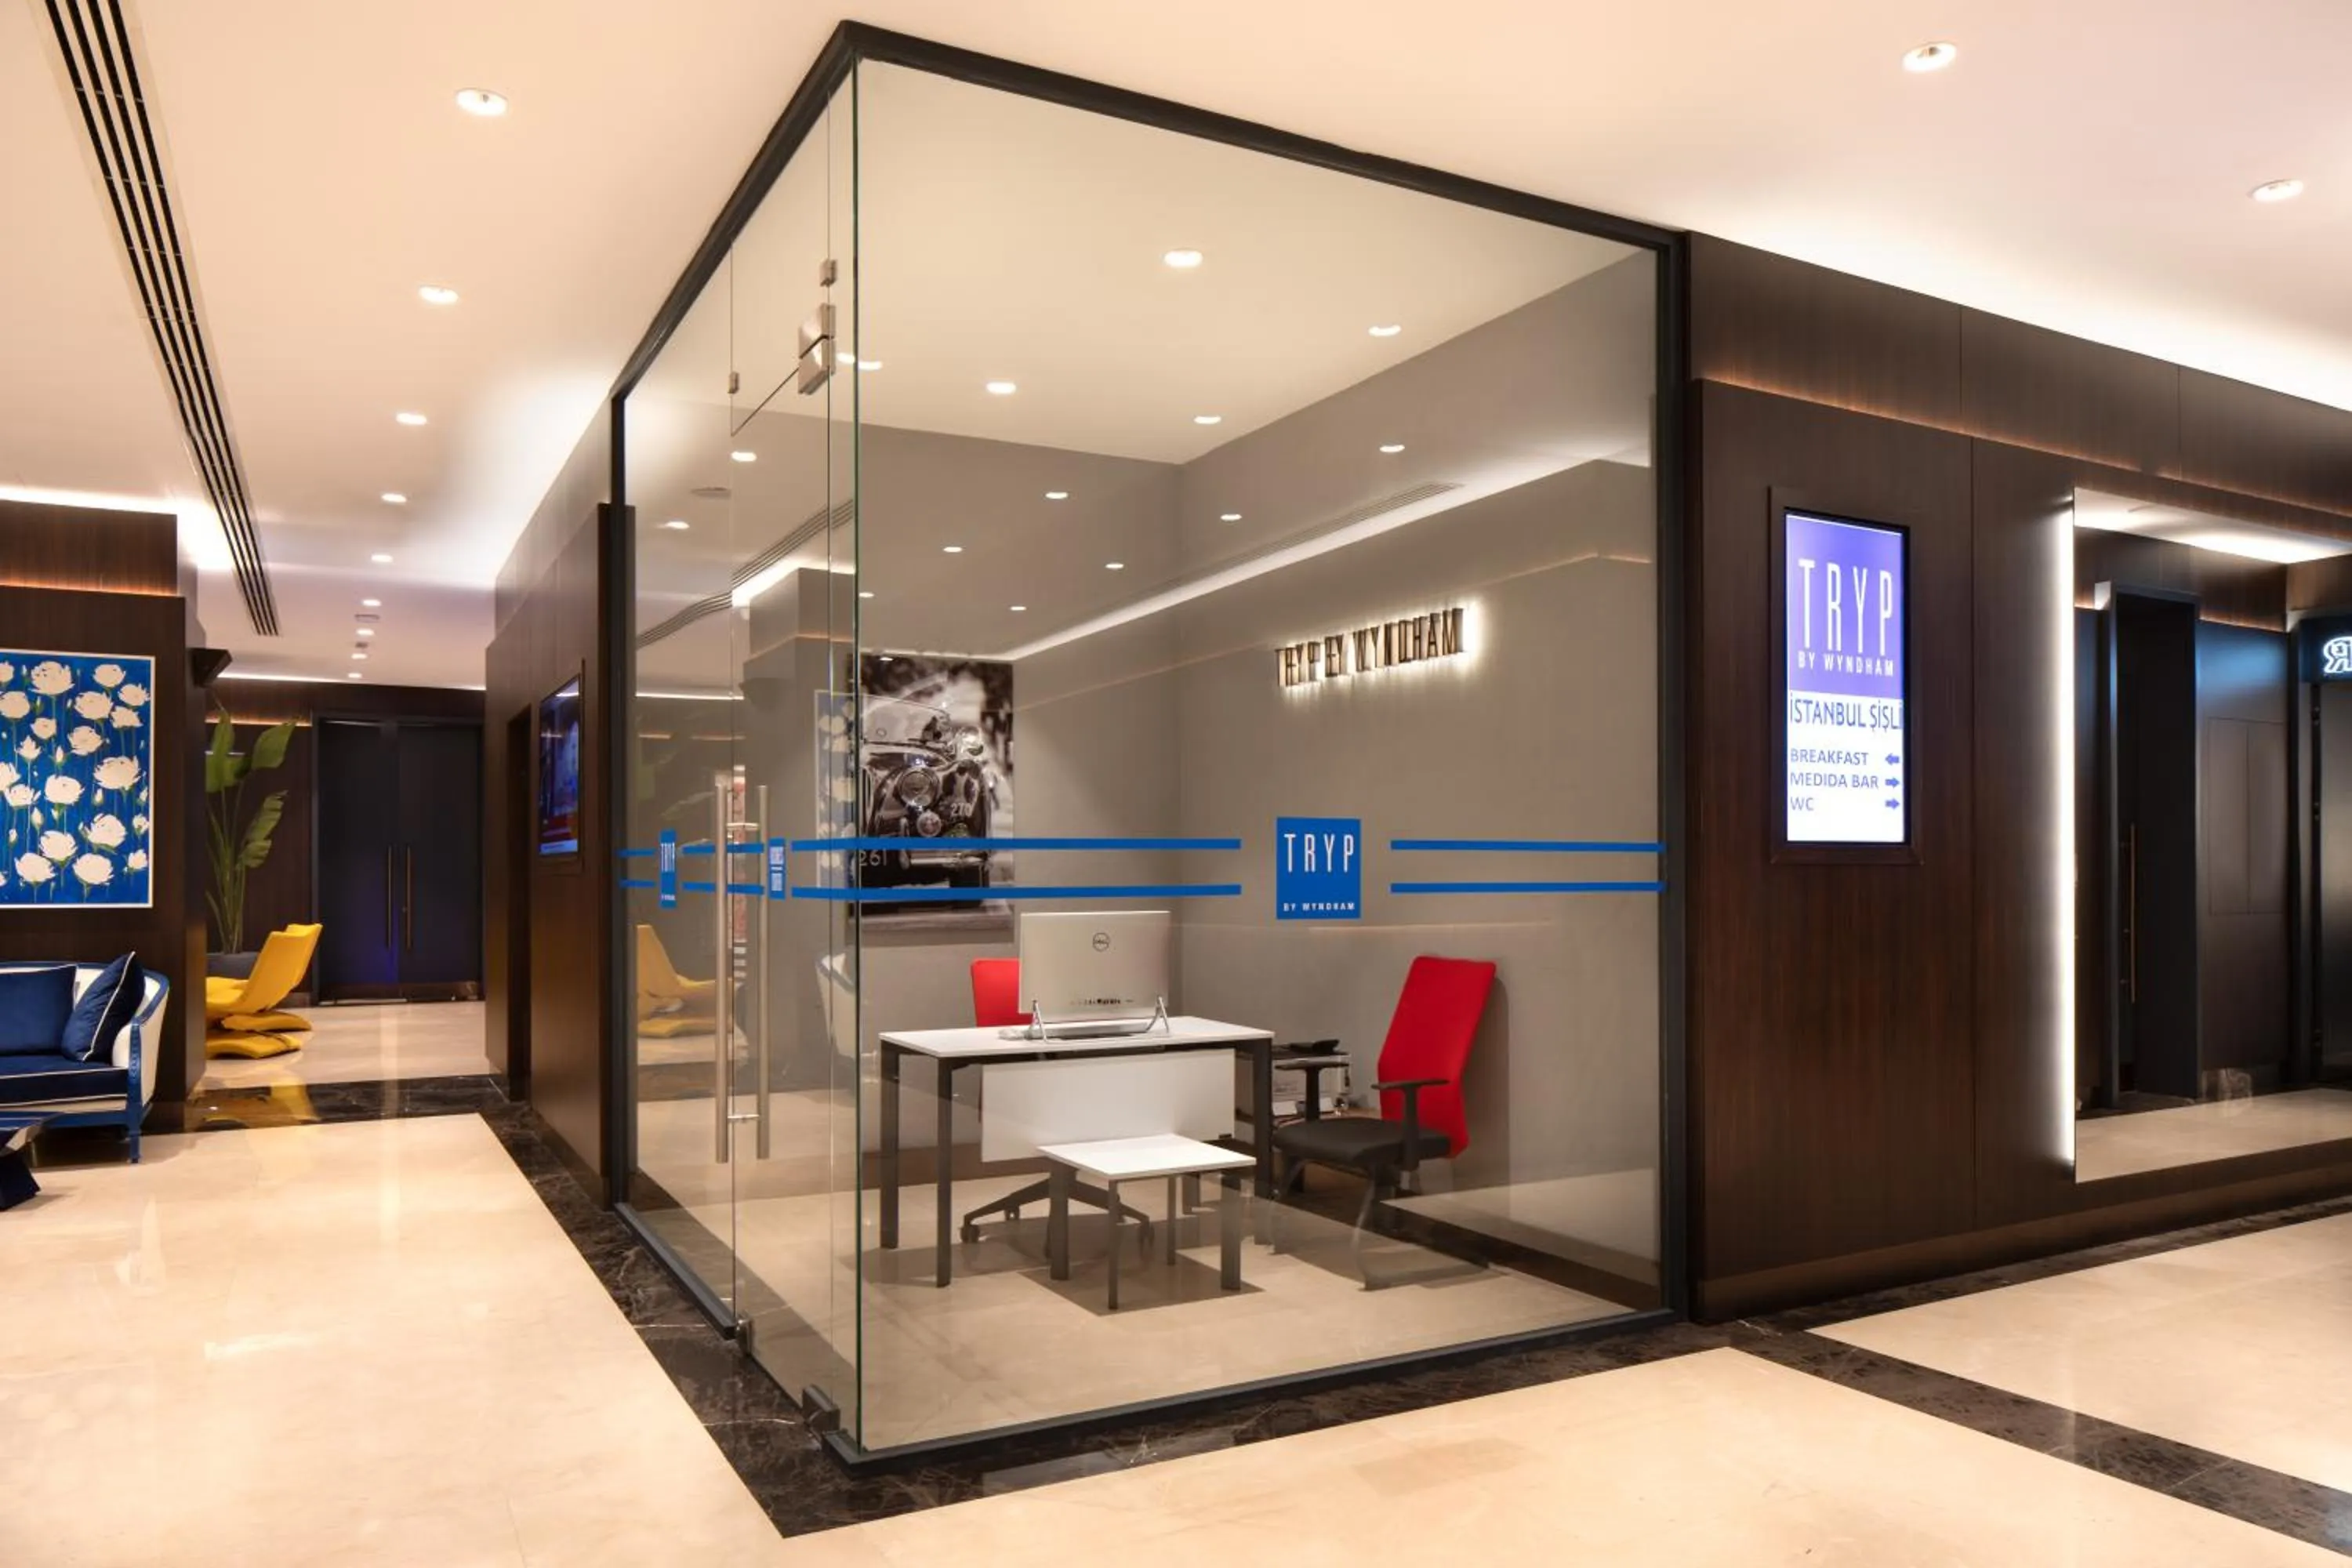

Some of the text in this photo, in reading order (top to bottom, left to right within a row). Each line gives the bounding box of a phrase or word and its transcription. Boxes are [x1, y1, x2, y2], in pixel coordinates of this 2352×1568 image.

[1798, 558, 1893, 656] TRYP
[1353, 608, 1464, 673] WYNDHAM
[1798, 651, 1893, 677] BY WYNDHAM
[1790, 692, 1867, 728] İSTANBUL
[1790, 748, 1869, 766] BREAKFAST
[1790, 771, 1879, 789] MEDIDA BAR
[1790, 796, 1814, 811] WC
[1283, 833, 1355, 873] TRYP
[1283, 902, 1356, 912] BY WYNDHAM
